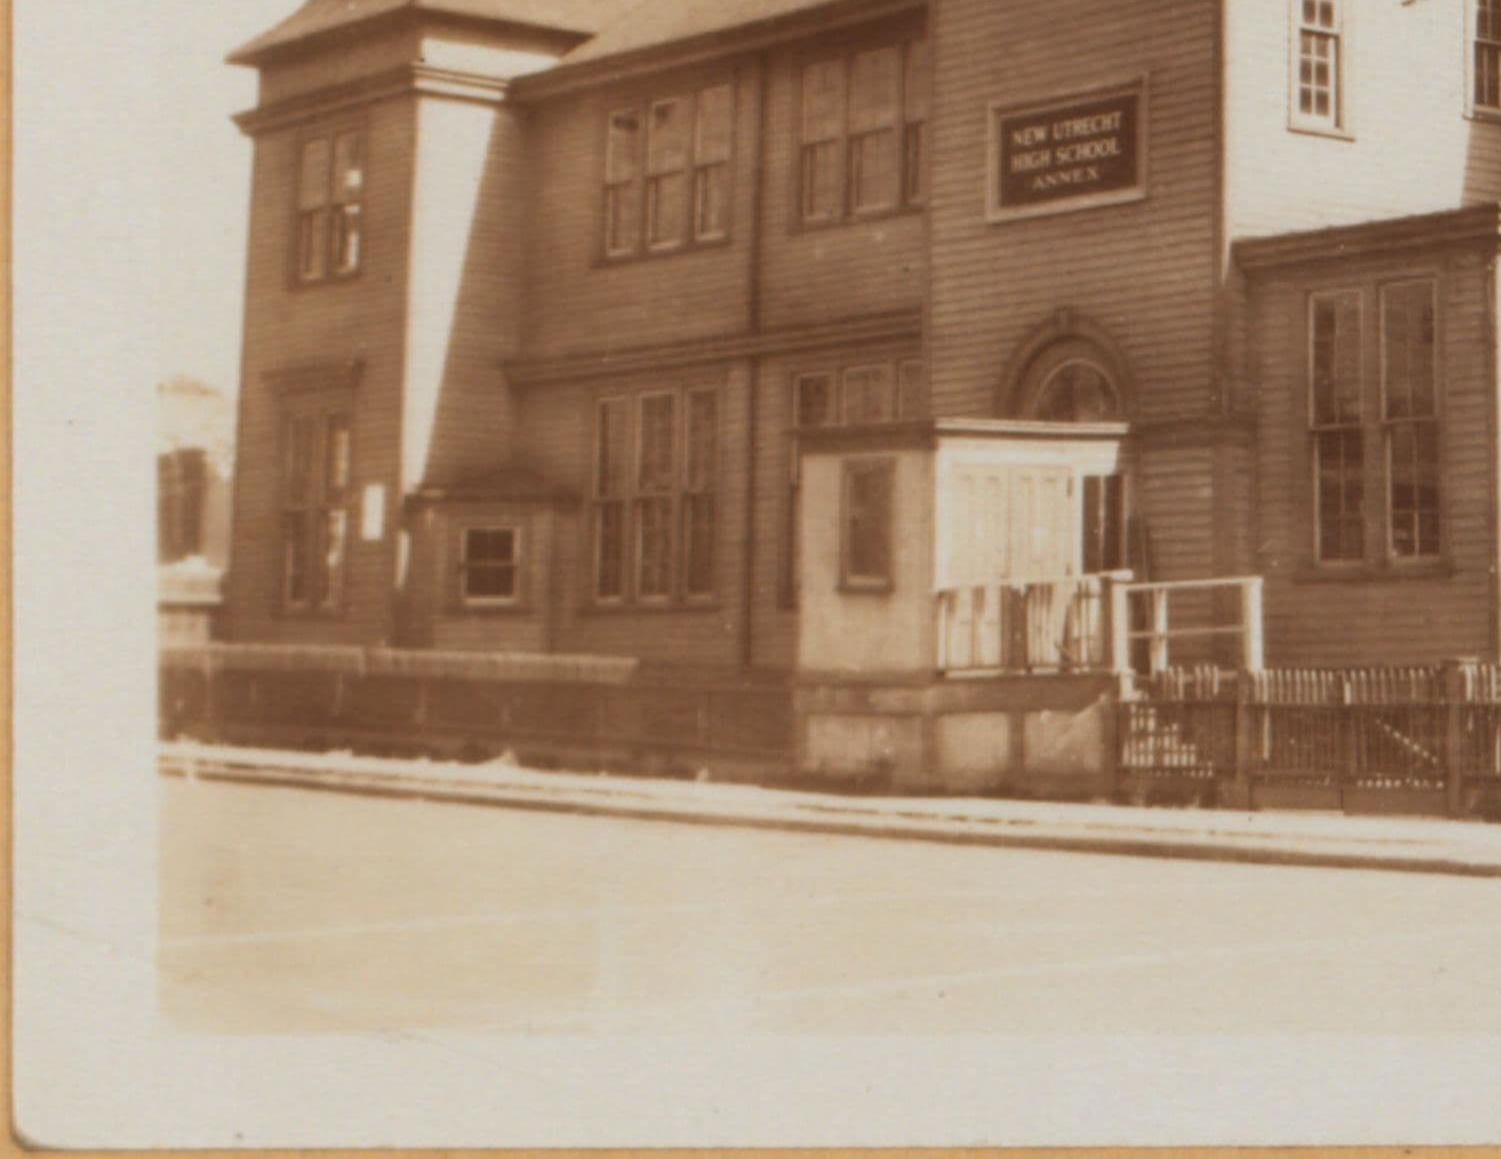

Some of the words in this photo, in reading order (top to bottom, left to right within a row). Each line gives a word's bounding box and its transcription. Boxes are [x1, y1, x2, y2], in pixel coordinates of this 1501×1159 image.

[1011, 126, 1048, 147] NEW
[1052, 111, 1122, 141] UTRECHT
[1011, 149, 1051, 173] HIGH
[1055, 137, 1122, 164] SCHOOL
[1032, 167, 1098, 190] ANNEX
